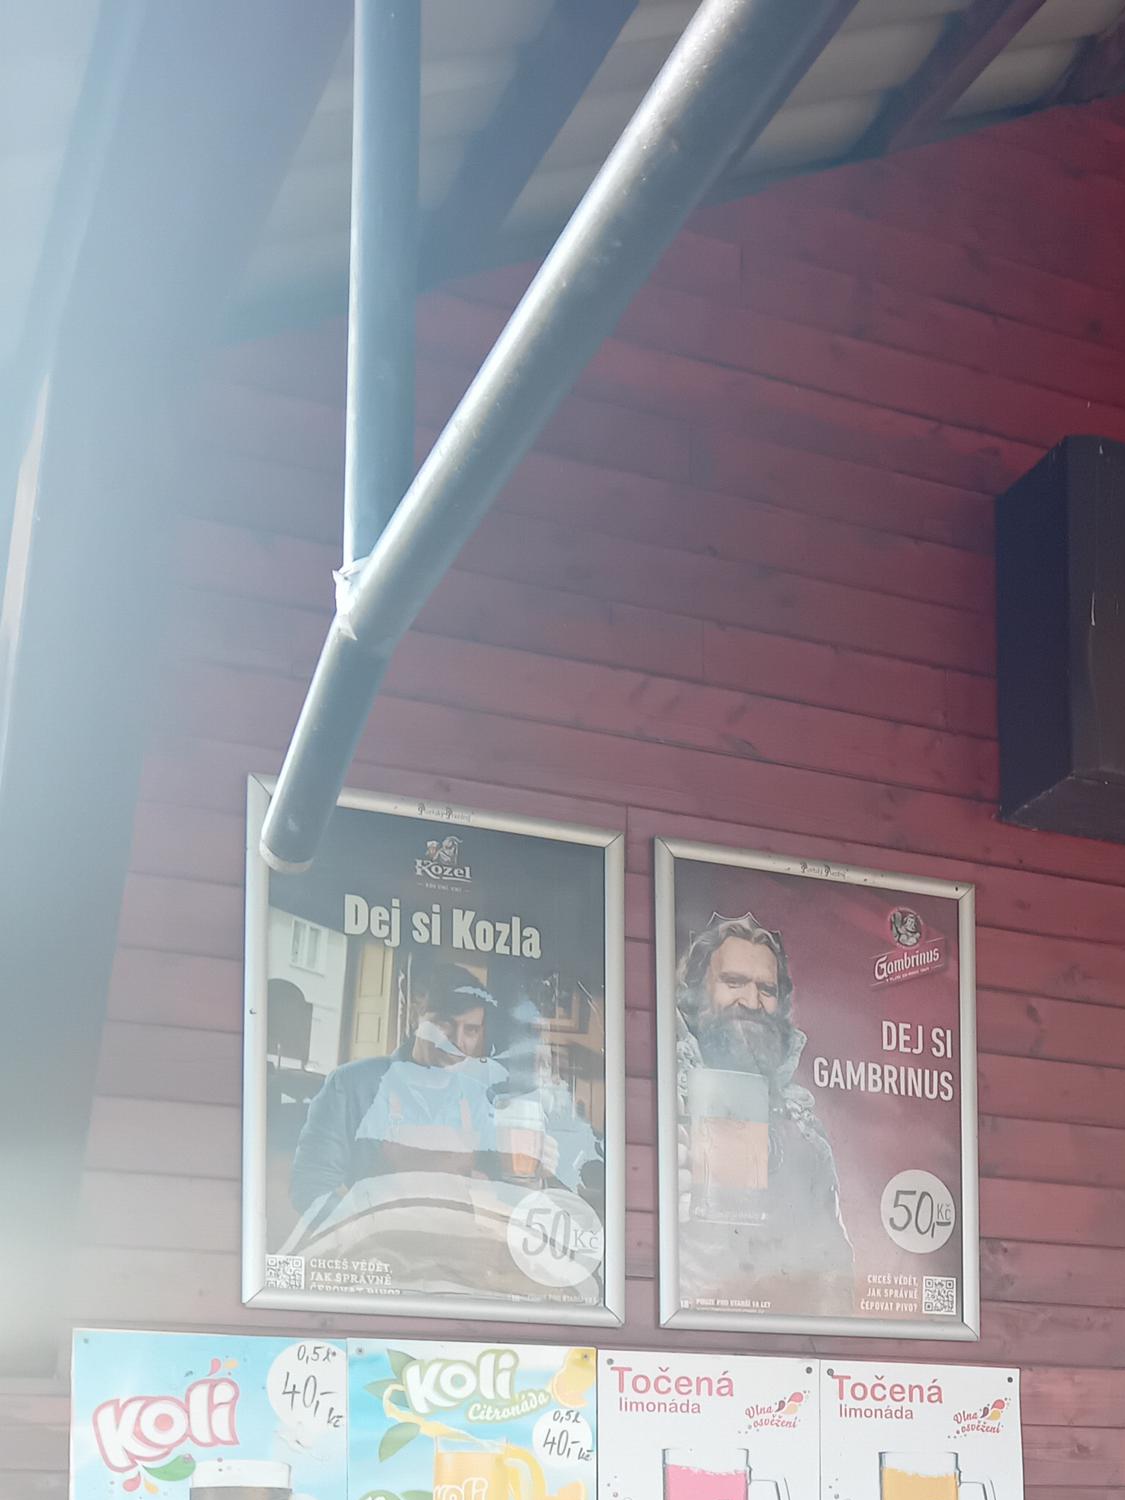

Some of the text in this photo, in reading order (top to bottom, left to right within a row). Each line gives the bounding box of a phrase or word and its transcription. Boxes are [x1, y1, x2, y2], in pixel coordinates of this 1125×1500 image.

[415, 859, 472, 881] Kozel
[344, 894, 542, 959] Dej si Kozla
[874, 947, 940, 982] Gambrinus
[881, 1020, 952, 1059] DEJ SI
[813, 1057, 954, 1102] GAMBRINUS
[310, 1257, 349, 1270] CHCEŠ
[310, 1271, 333, 1282] JAK
[611, 1366, 734, 1398] Točená
[832, 1375, 943, 1404] Točená
[468, 1389, 549, 1421] Citronáda
[619, 1397, 701, 1414] limonáda
[839, 1404, 914, 1420] limonáda
